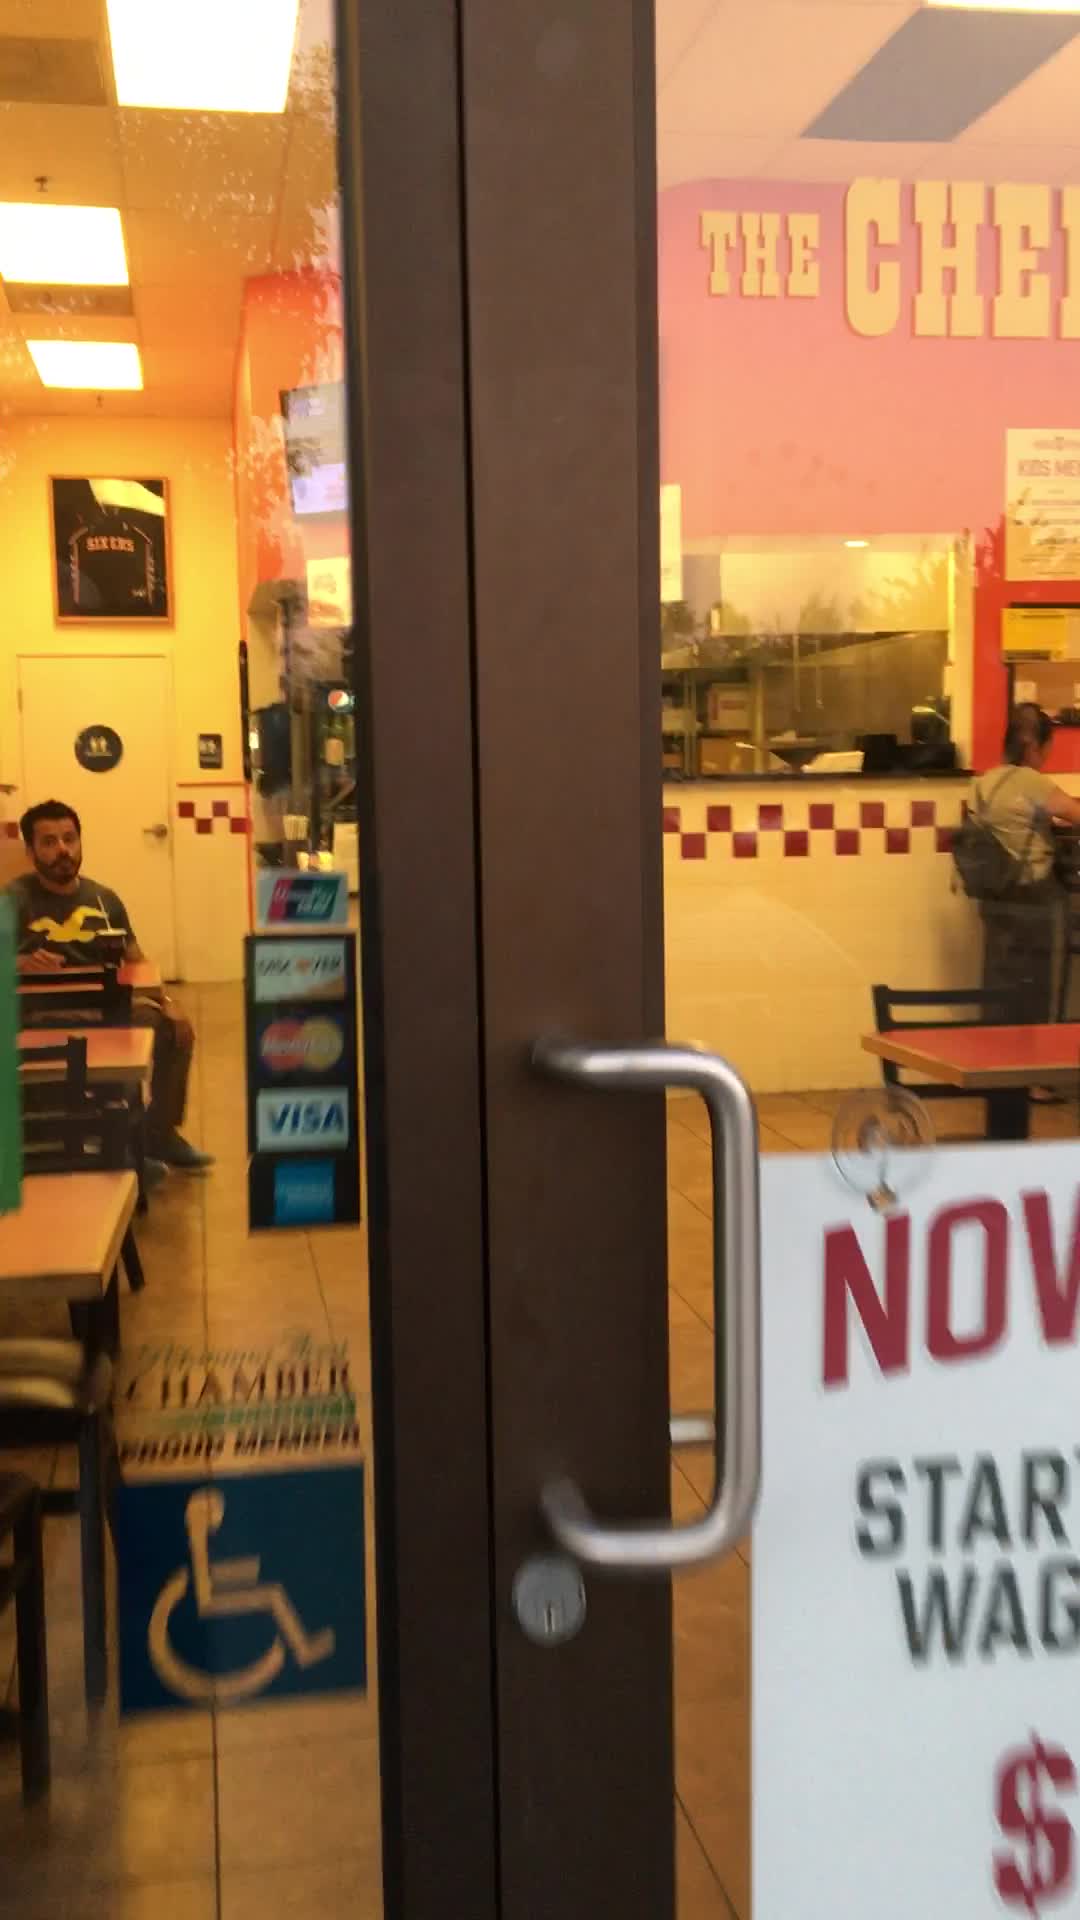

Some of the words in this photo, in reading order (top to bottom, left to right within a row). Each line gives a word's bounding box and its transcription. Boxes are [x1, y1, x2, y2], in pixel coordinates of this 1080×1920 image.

[700, 210, 820, 298] THE
[843, 177, 1080, 340] CHE
[268, 1102, 345, 1135] VISA
[856, 1446, 1080, 1562] STAR
